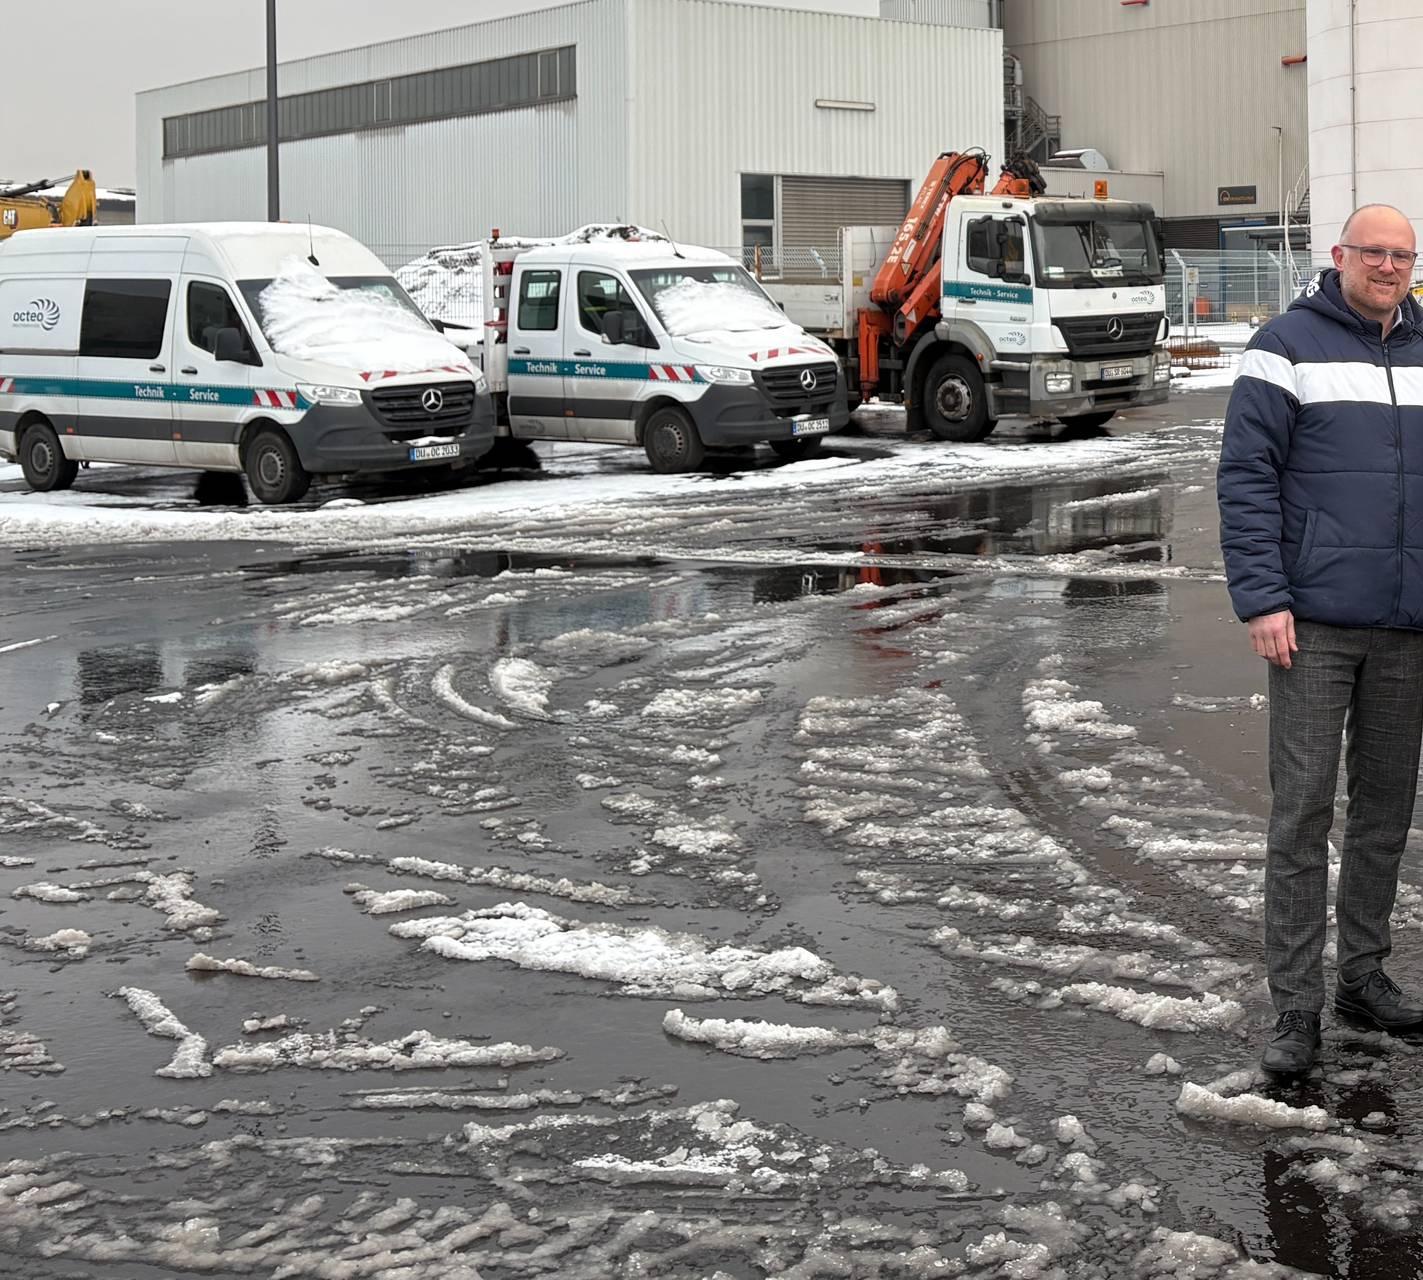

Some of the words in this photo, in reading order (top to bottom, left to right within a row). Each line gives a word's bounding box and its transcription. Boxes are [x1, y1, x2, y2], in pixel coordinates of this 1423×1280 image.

[3, 209, 16, 225] CAT
[887, 217, 918, 263] 165.2E
[970, 287, 991, 297] Technik
[997, 290, 1018, 299] Service
[13, 311, 44, 322] octeo
[526, 362, 558, 373] Technik
[574, 363, 606, 375] Service
[134, 385, 164, 398] Technik
[189, 388, 219, 401] Service
